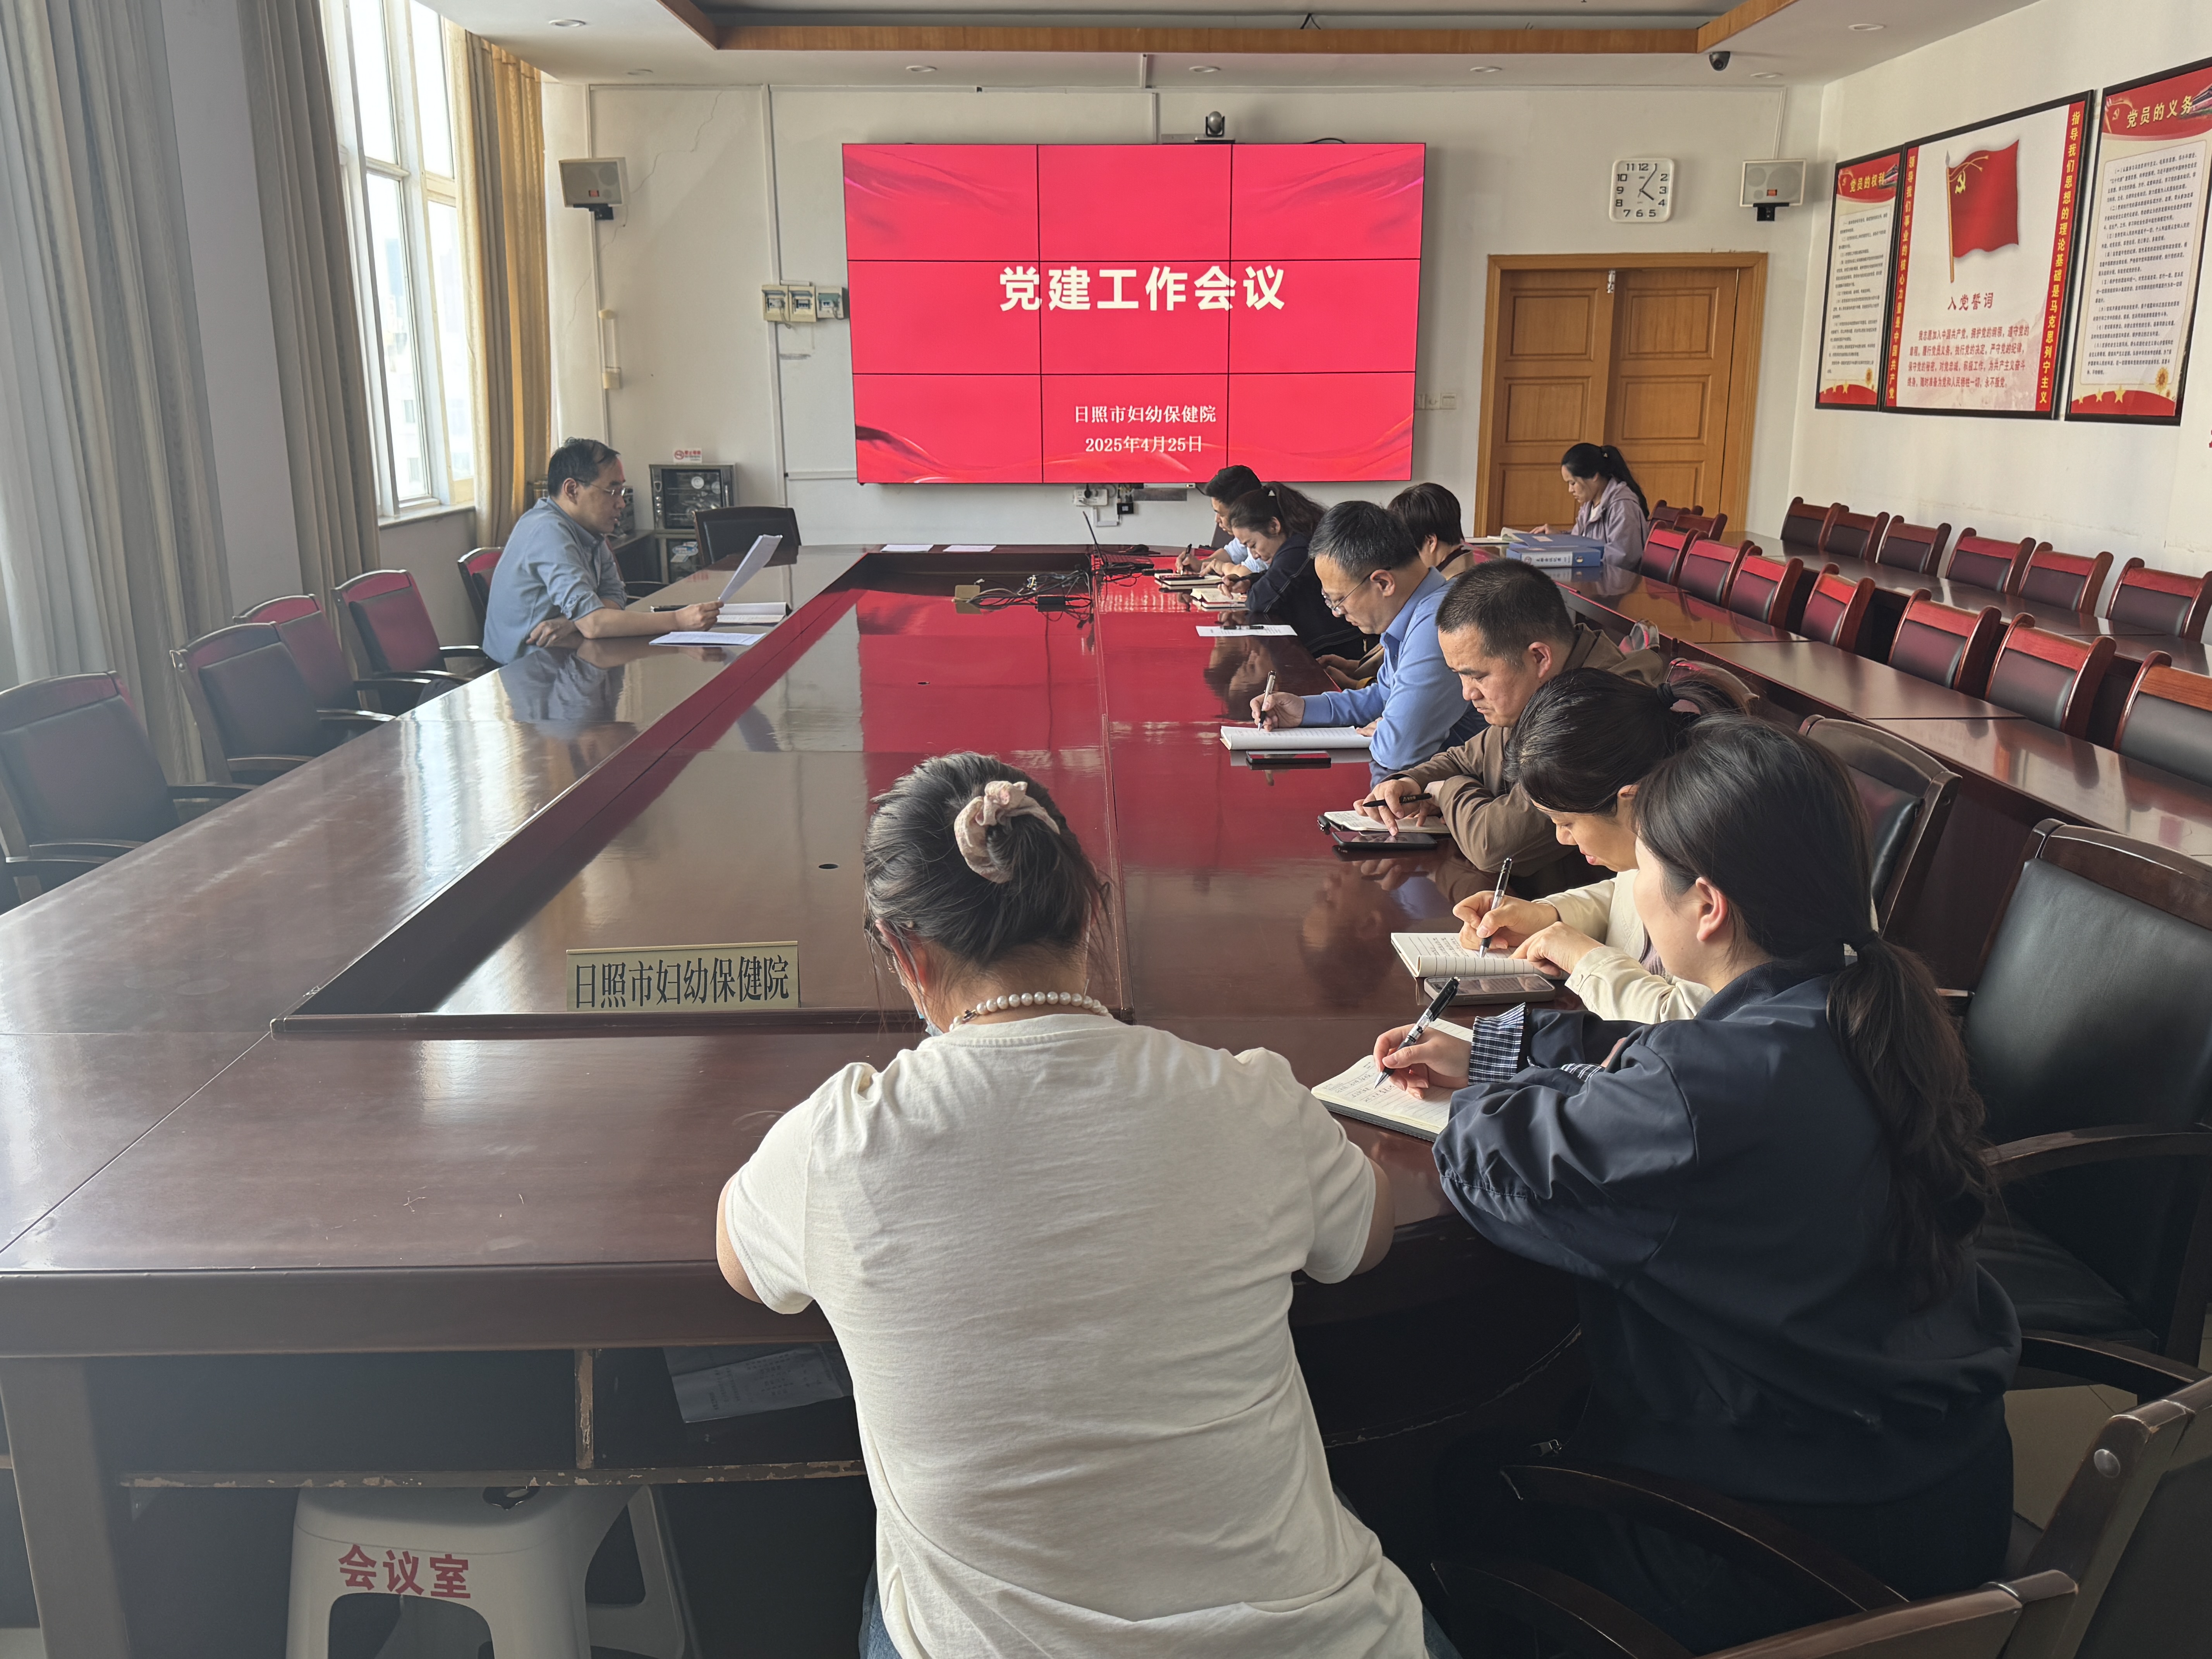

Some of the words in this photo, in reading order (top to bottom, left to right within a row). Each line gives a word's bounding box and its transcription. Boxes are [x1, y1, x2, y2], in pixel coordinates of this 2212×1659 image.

[2126, 95, 2193, 129] 党员的义务
[1626, 163, 1635, 171] 11
[1617, 173, 1628, 182] 10
[1660, 173, 1668, 181] 2
[1850, 172, 1885, 192] 党员的权利
[1623, 209, 1631, 217] 7
[2039, 111, 2081, 404] 指导我们思想的理论基础是马克思列宁主义
[1889, 156, 1916, 399] 领导我们事业的核心力量是中国共产党
[1000, 265, 1285, 312] 党建工作会议
[1947, 292, 1994, 311] 入党誓词
[1074, 405, 1217, 424] 日照市妇幼保健院
[1085, 435, 1203, 454] 2025年4月25日
[576, 954, 790, 1009] 日照市妇幼保健院
[338, 1544, 471, 1599] 会议室
